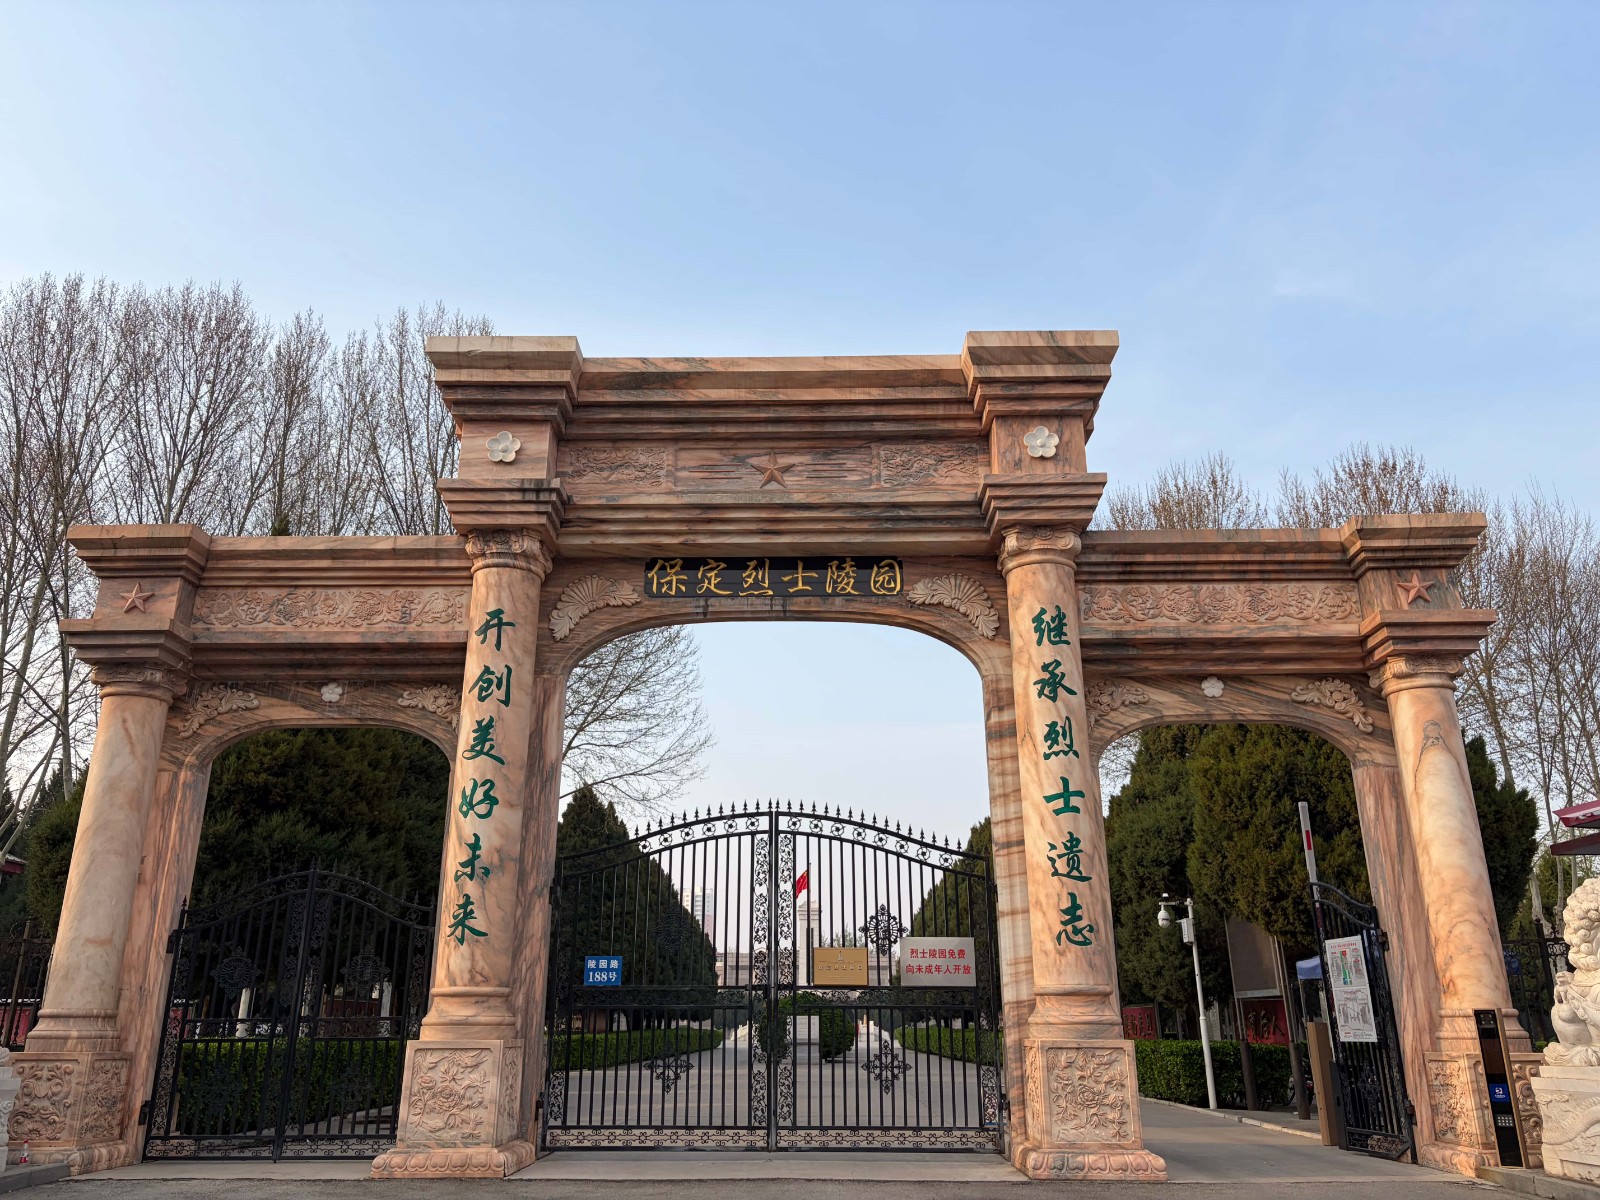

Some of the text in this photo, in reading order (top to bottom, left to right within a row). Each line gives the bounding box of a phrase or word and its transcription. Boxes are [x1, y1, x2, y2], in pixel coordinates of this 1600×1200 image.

[647, 558, 902, 596] 保定烈士陵园
[447, 607, 516, 947] 开创美好未来
[1031, 604, 1094, 947] 继承烈士遗志
[910, 948, 966, 959] 烈士陵园免费
[588, 960, 618, 968] 陵园路
[905, 964, 971, 975] 向未成年人开放
[589, 972, 616, 981] 188号
